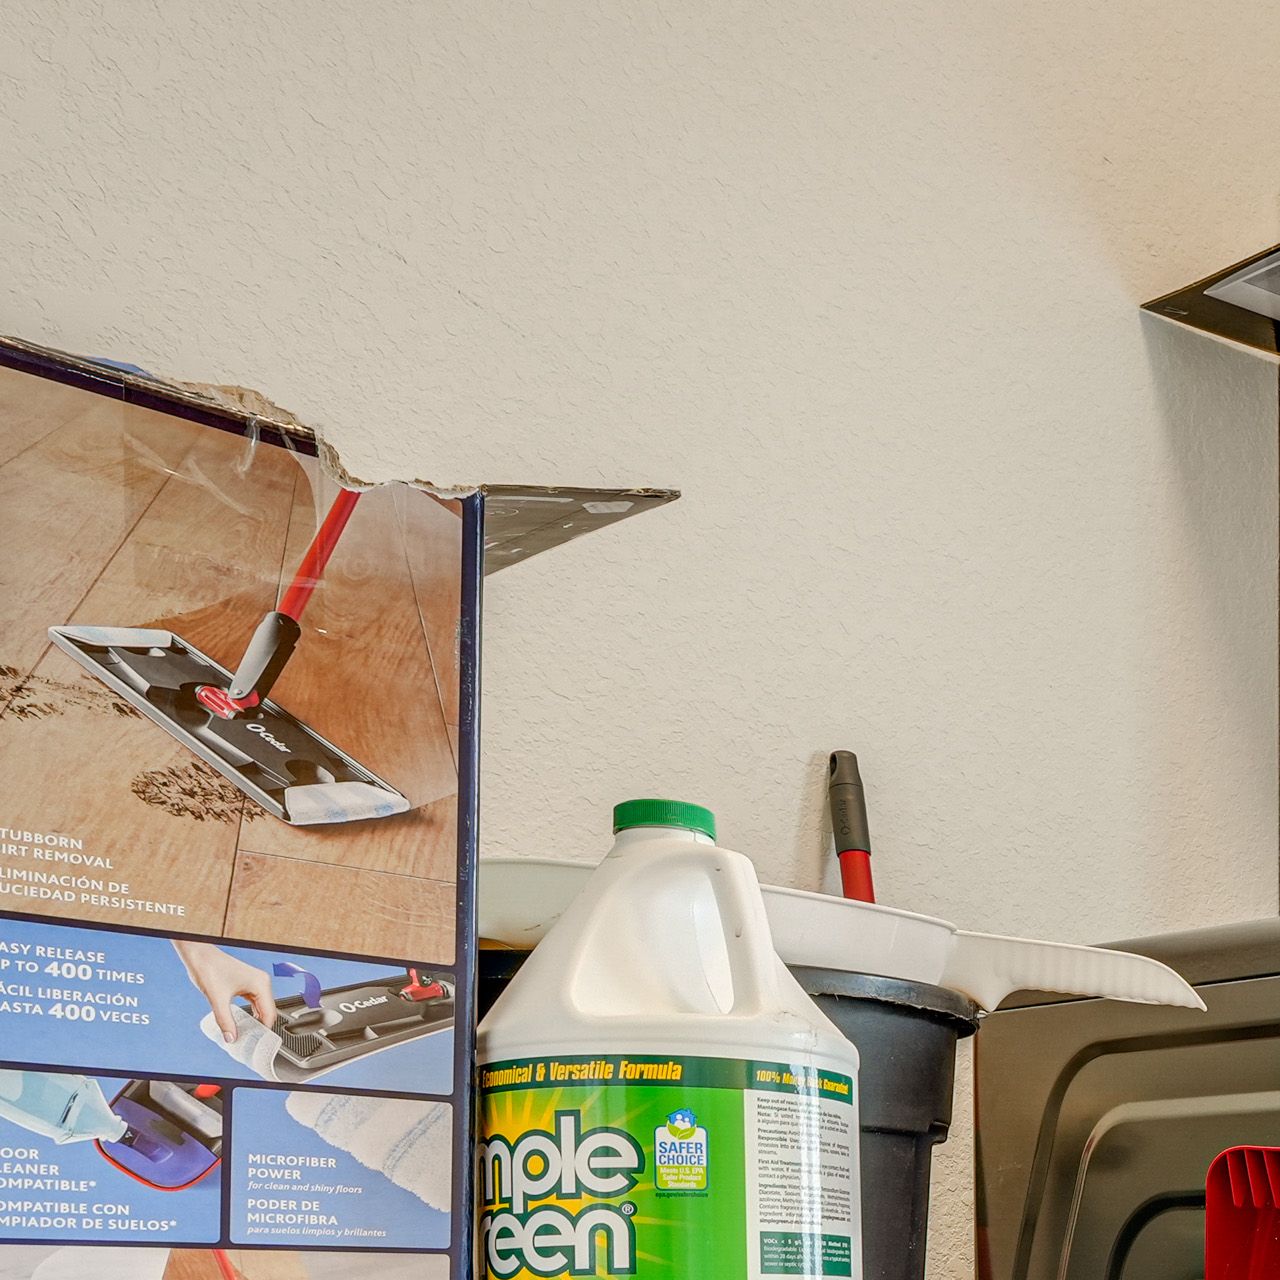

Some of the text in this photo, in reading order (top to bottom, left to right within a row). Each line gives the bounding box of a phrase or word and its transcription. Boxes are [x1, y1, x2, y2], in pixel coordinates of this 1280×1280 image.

[33, 847, 113, 869] REMOVAL
[0, 867, 129, 894] LIMINACIÓN DE
[0, 883, 186, 917] UCIEDAD PERSISTENTE
[36, 945, 105, 963] RELEASE
[15, 960, 145, 984] TO 400 TIMES
[38, 987, 138, 1008] LIBERACIÓN
[339, 995, 389, 1013] O-Cedar
[48, 1003, 150, 1025] 400 VECES
[482, 1060, 683, 1089] Economical & Versatile Formula
[658, 1141, 703, 1154] SAFER
[248, 1154, 337, 1168] MICROFIBER
[658, 1154, 705, 1166] CHOICE
[248, 1168, 301, 1180] POWER
[92, 1203, 130, 1216] CON
[247, 1199, 320, 1212] PODER DE
[82, 1218, 103, 1230] DE
[247, 1213, 338, 1226] MICROFIBRA
